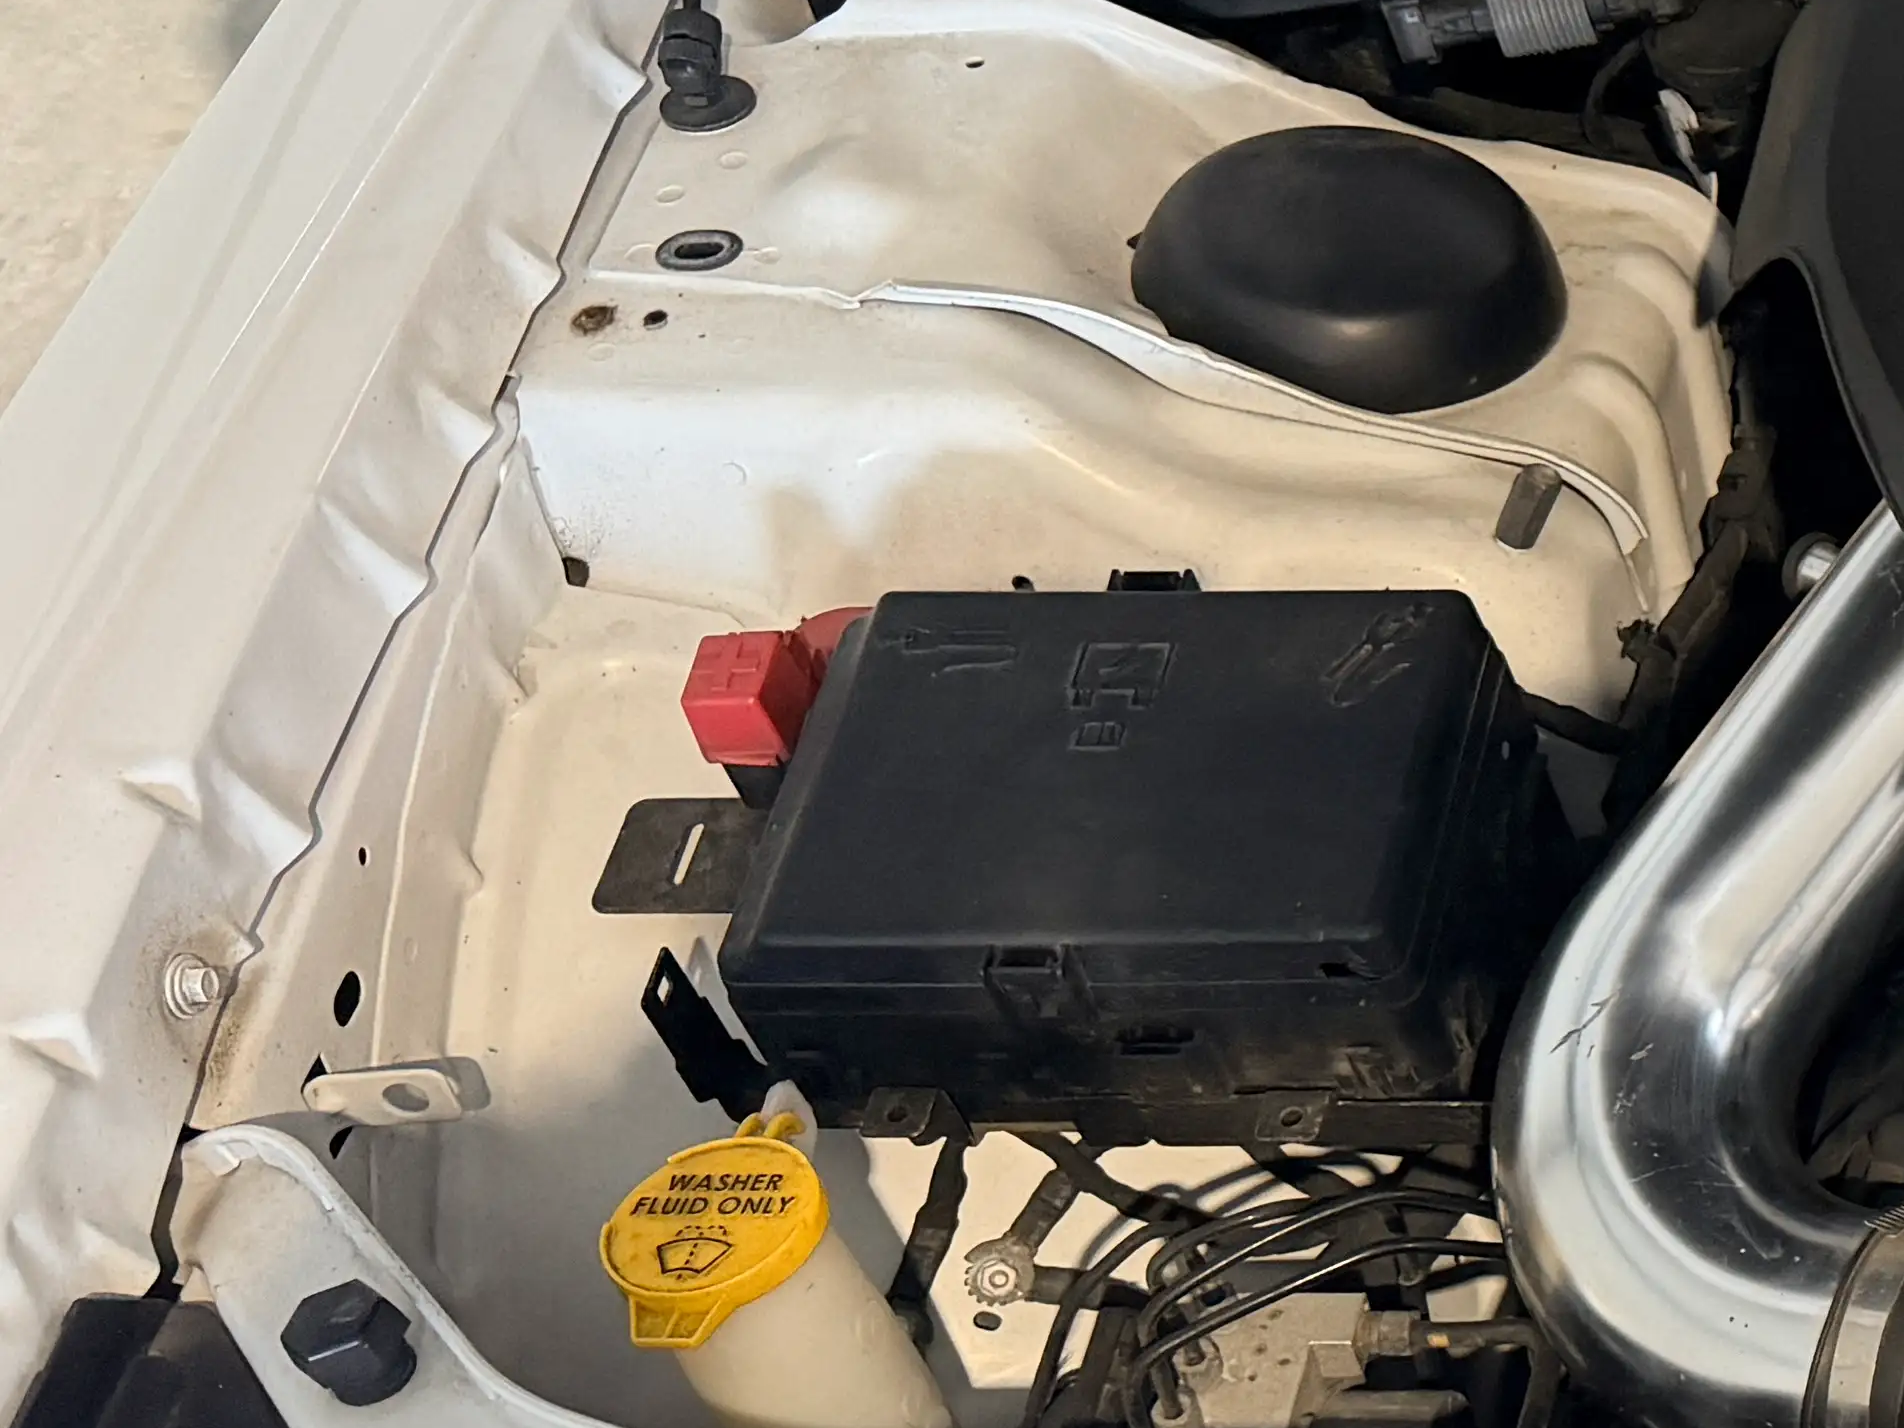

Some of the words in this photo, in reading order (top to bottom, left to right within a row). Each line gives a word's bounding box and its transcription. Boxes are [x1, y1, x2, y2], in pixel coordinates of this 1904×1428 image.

[668, 1173, 784, 1192] WASHER
[629, 1196, 709, 1216] FLUID
[717, 1196, 796, 1216] ONLY
